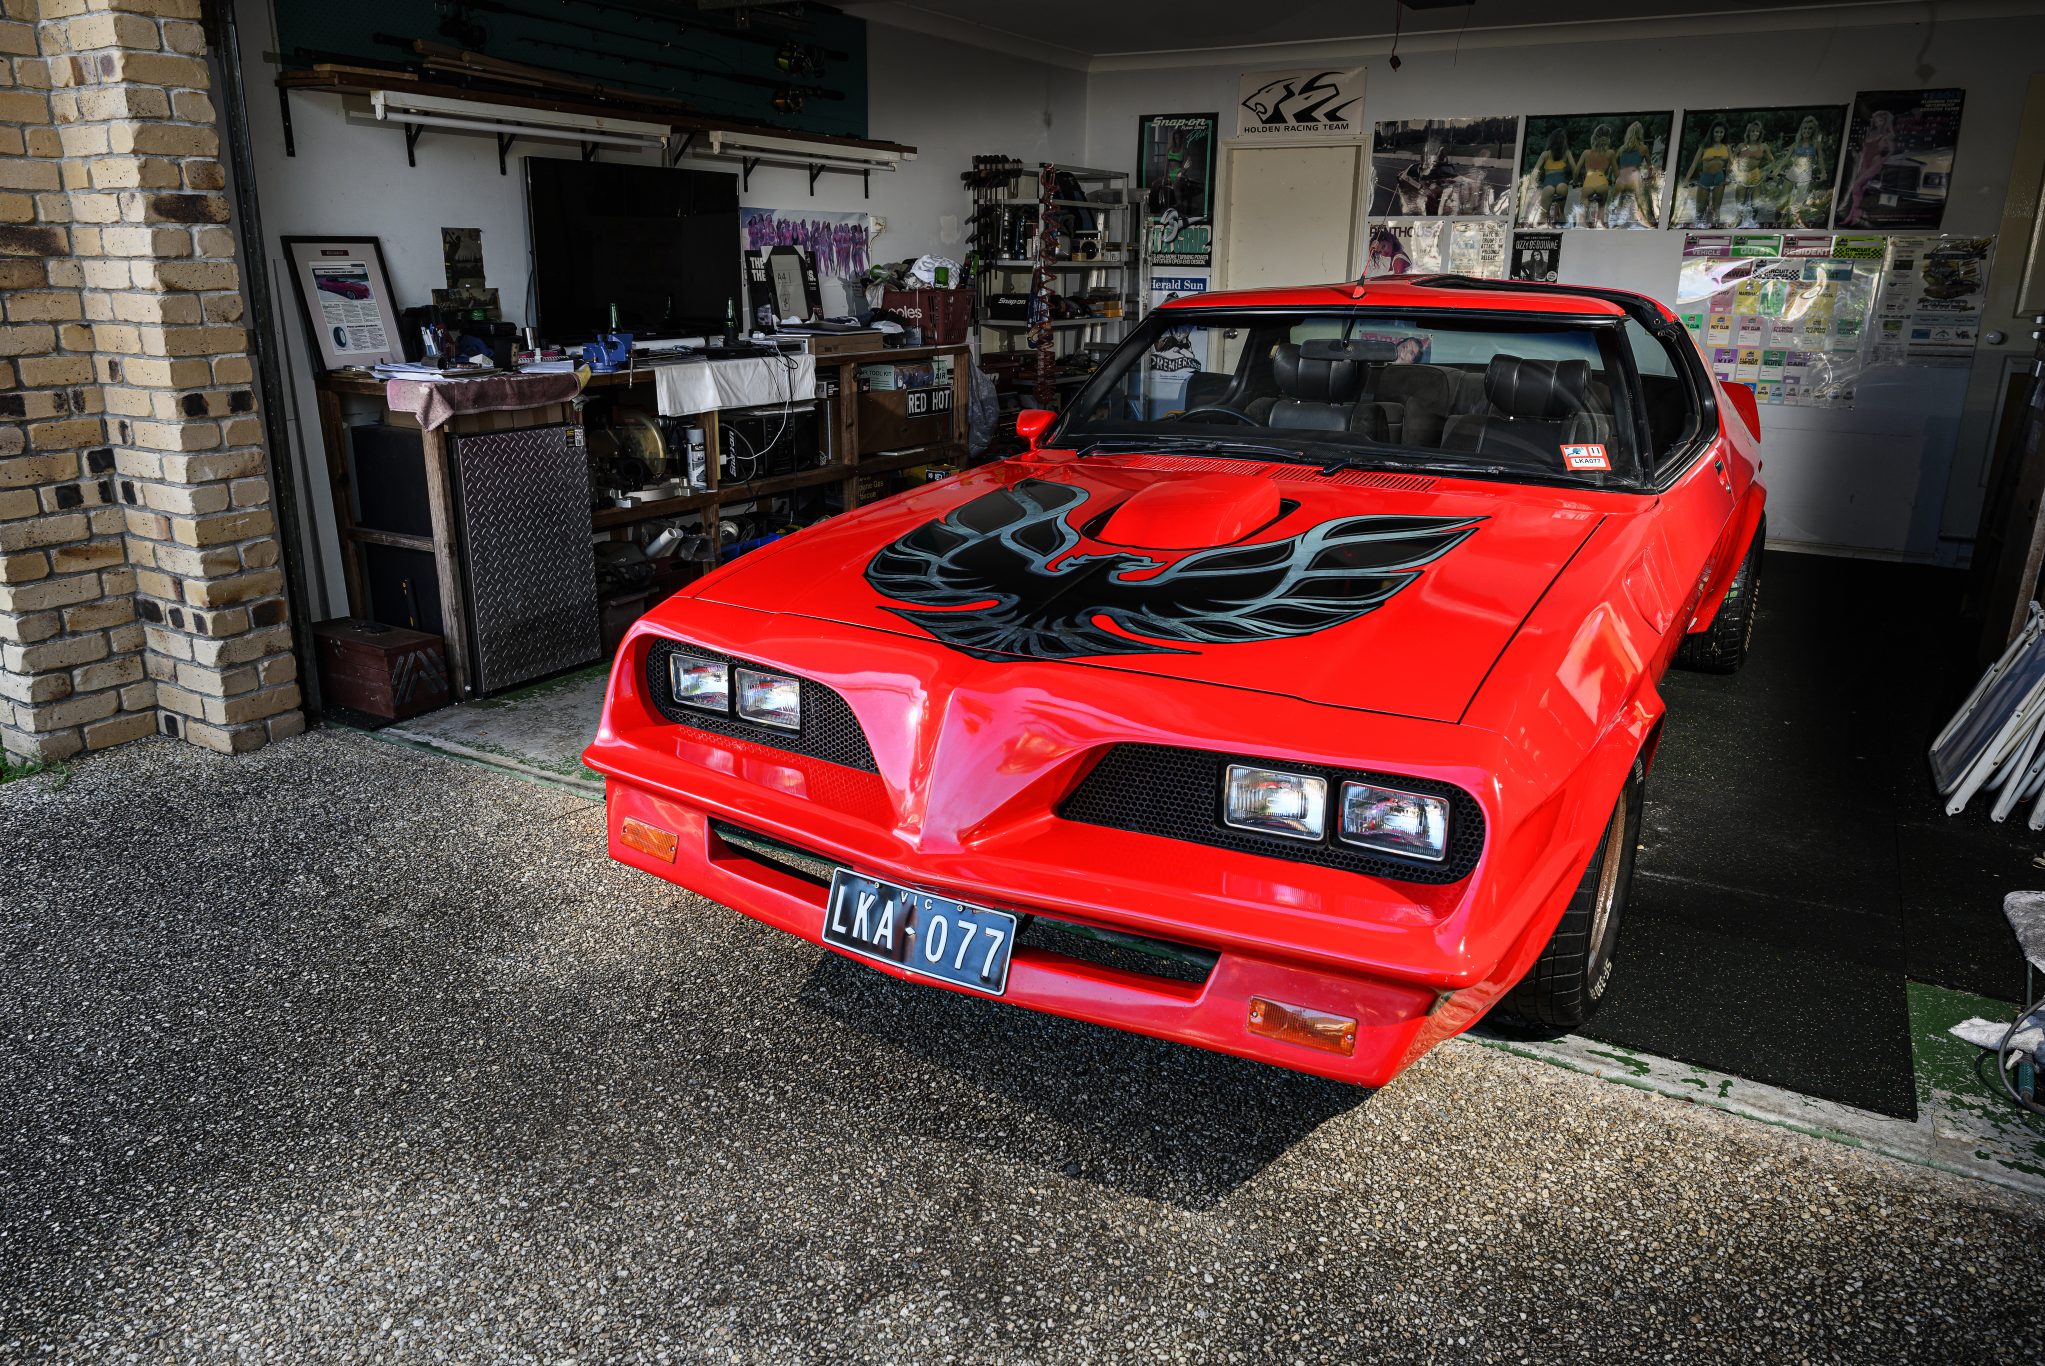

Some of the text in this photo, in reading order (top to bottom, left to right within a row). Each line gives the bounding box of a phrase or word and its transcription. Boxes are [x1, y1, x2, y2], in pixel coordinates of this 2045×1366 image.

[1152, 116, 1206, 129] Snap-on
[1244, 123, 1349, 134] HOLDEN RACING TEAM
[1516, 241, 1529, 249] OZZY
[750, 257, 765, 269] THE
[751, 270, 767, 281] THE
[1184, 280, 1203, 290] Sun
[908, 390, 950, 414] RED HOT
[901, 891, 933, 910] VIC
[832, 885, 1005, 977] LKA 077
